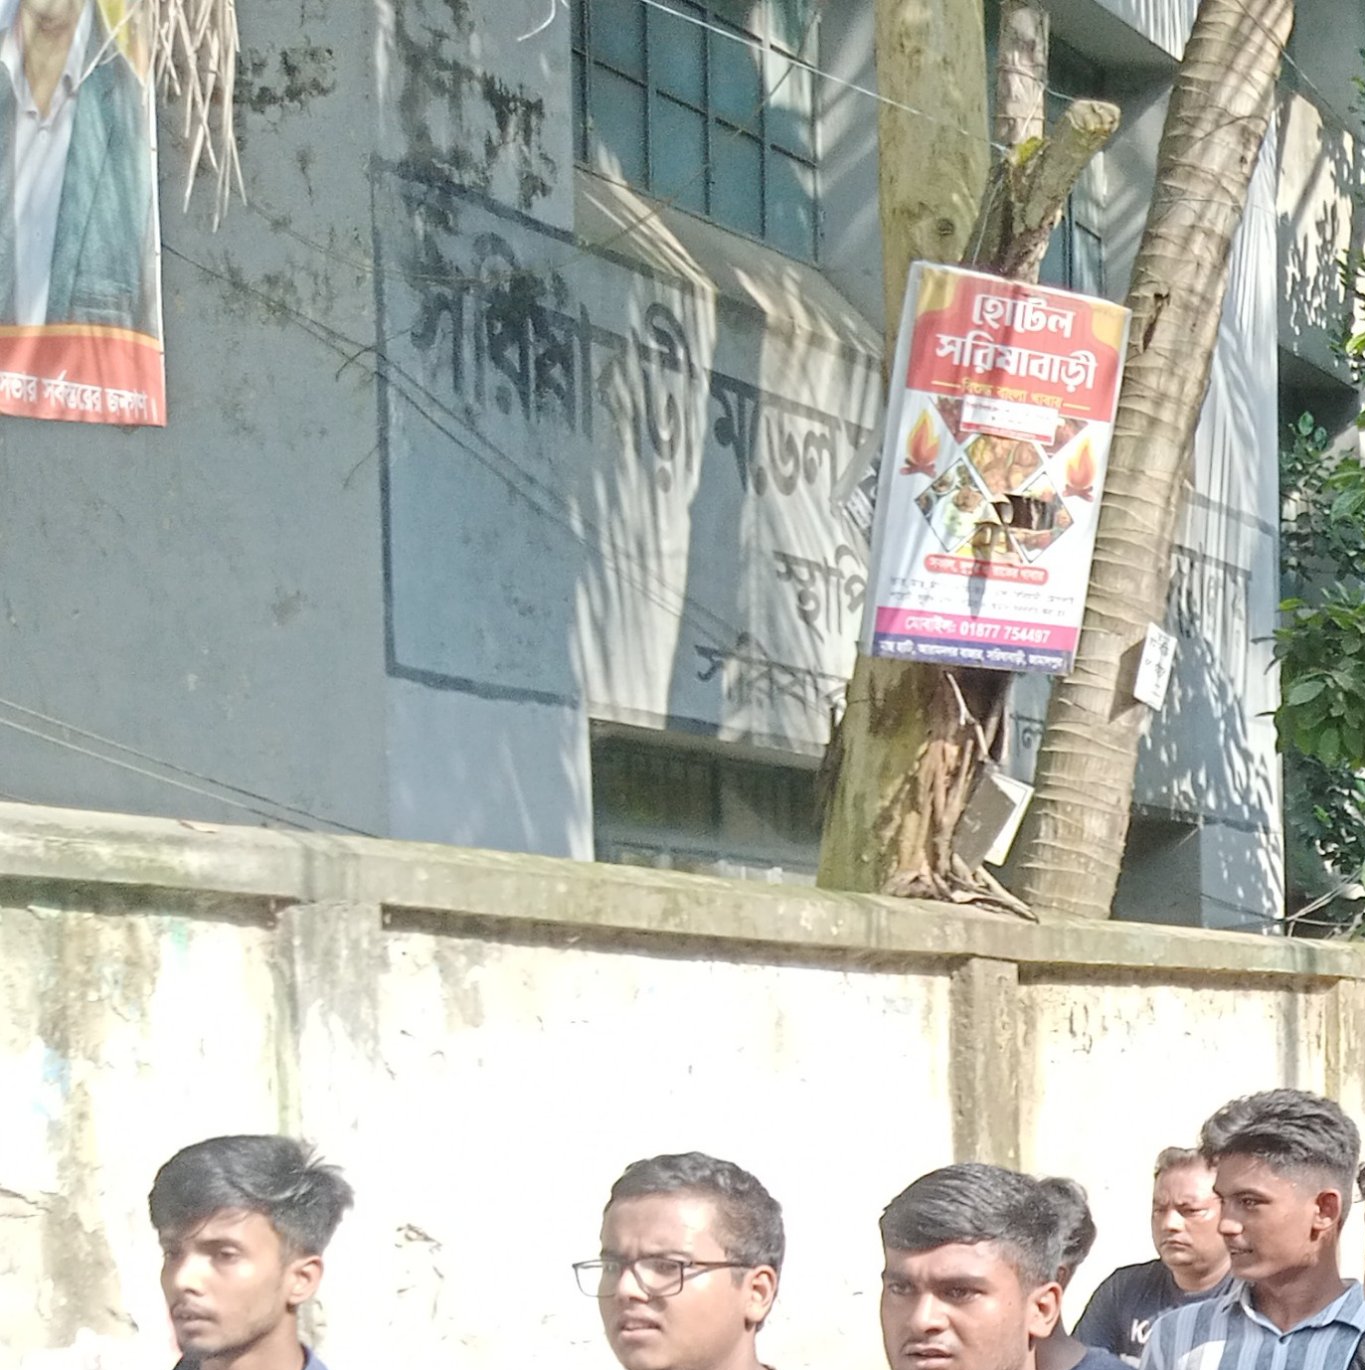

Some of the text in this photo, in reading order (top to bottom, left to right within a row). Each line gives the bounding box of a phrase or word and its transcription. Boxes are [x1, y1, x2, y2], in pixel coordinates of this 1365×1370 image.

[972, 293, 1075, 339] হোটেল
[935, 332, 1097, 393] সরিষাবাড়ী
[959, 621, 1001, 638] 01877
[1003, 626, 1050, 644] 754497
